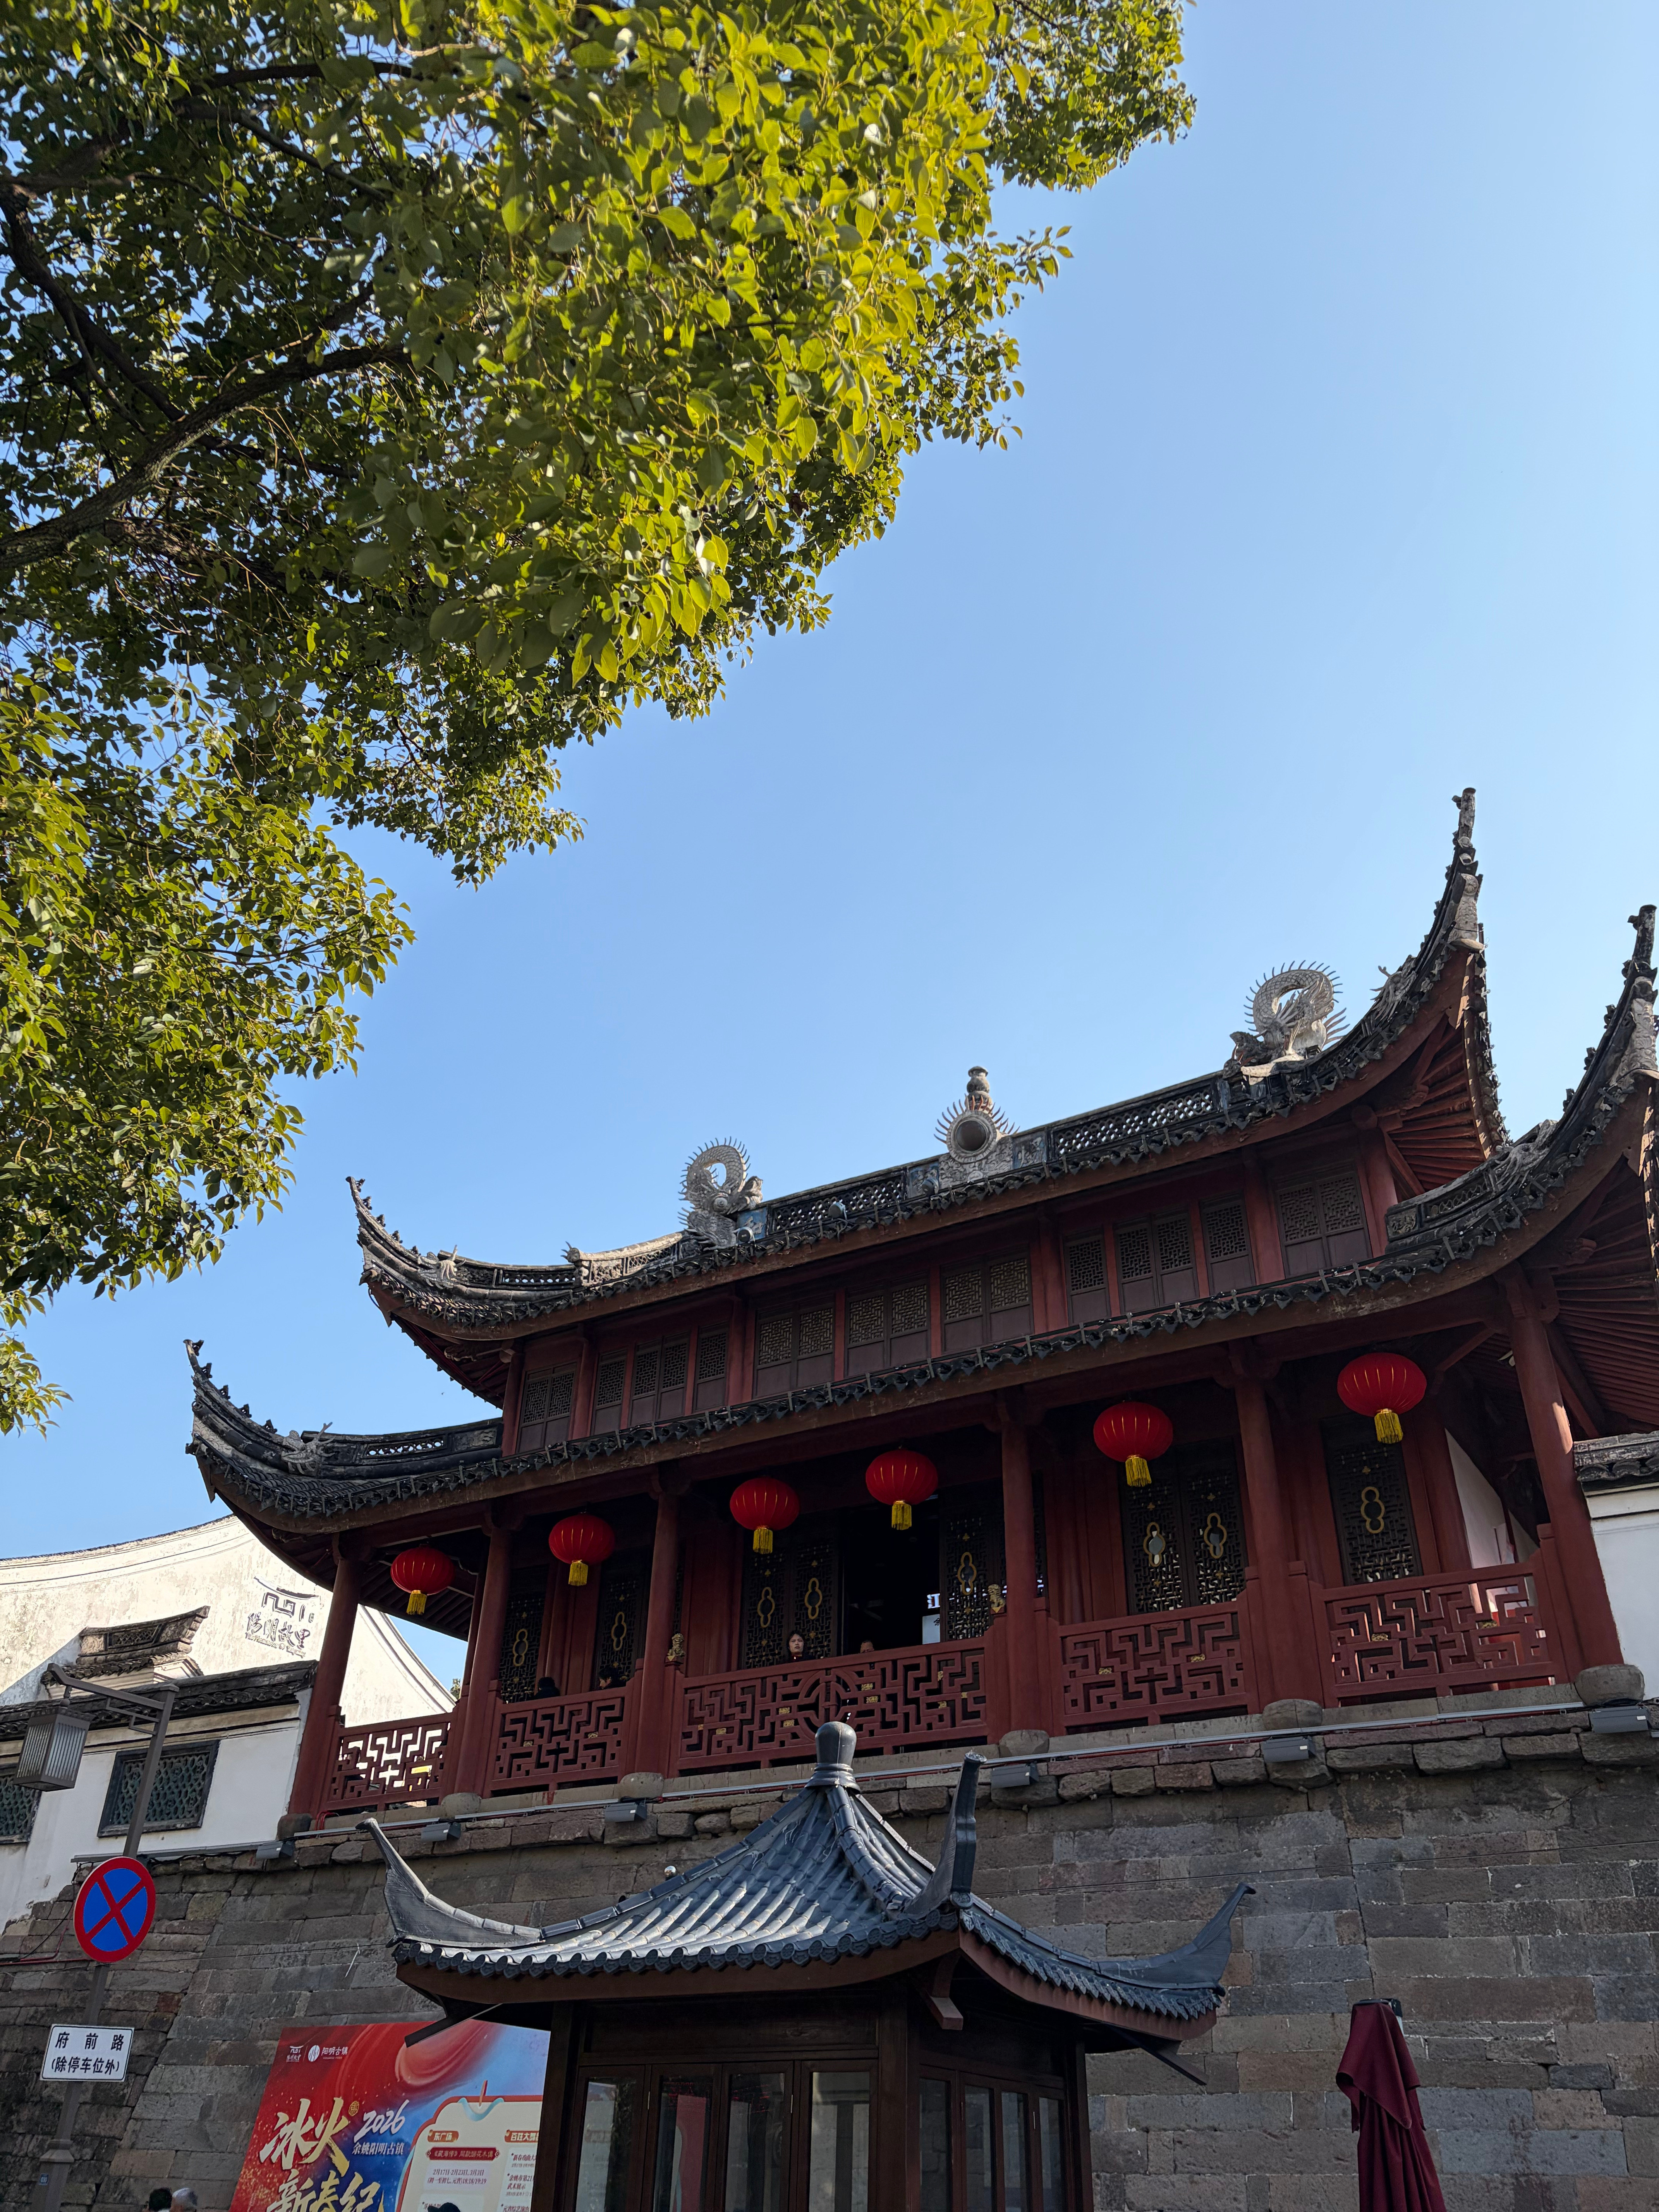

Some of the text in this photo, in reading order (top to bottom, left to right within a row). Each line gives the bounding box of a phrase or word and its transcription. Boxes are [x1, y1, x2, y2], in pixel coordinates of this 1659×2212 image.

[55, 2032, 124, 2051] 府前路
[321, 2046, 348, 2056] 阳明古镇
[52, 2056, 119, 2075] (除停车位外)
[354, 2099, 410, 2143] 2026
[259, 2097, 350, 2177] 冰火
[433, 2133, 453, 2141] 东广场
[352, 2142, 404, 2155] 余姚阳明古镇
